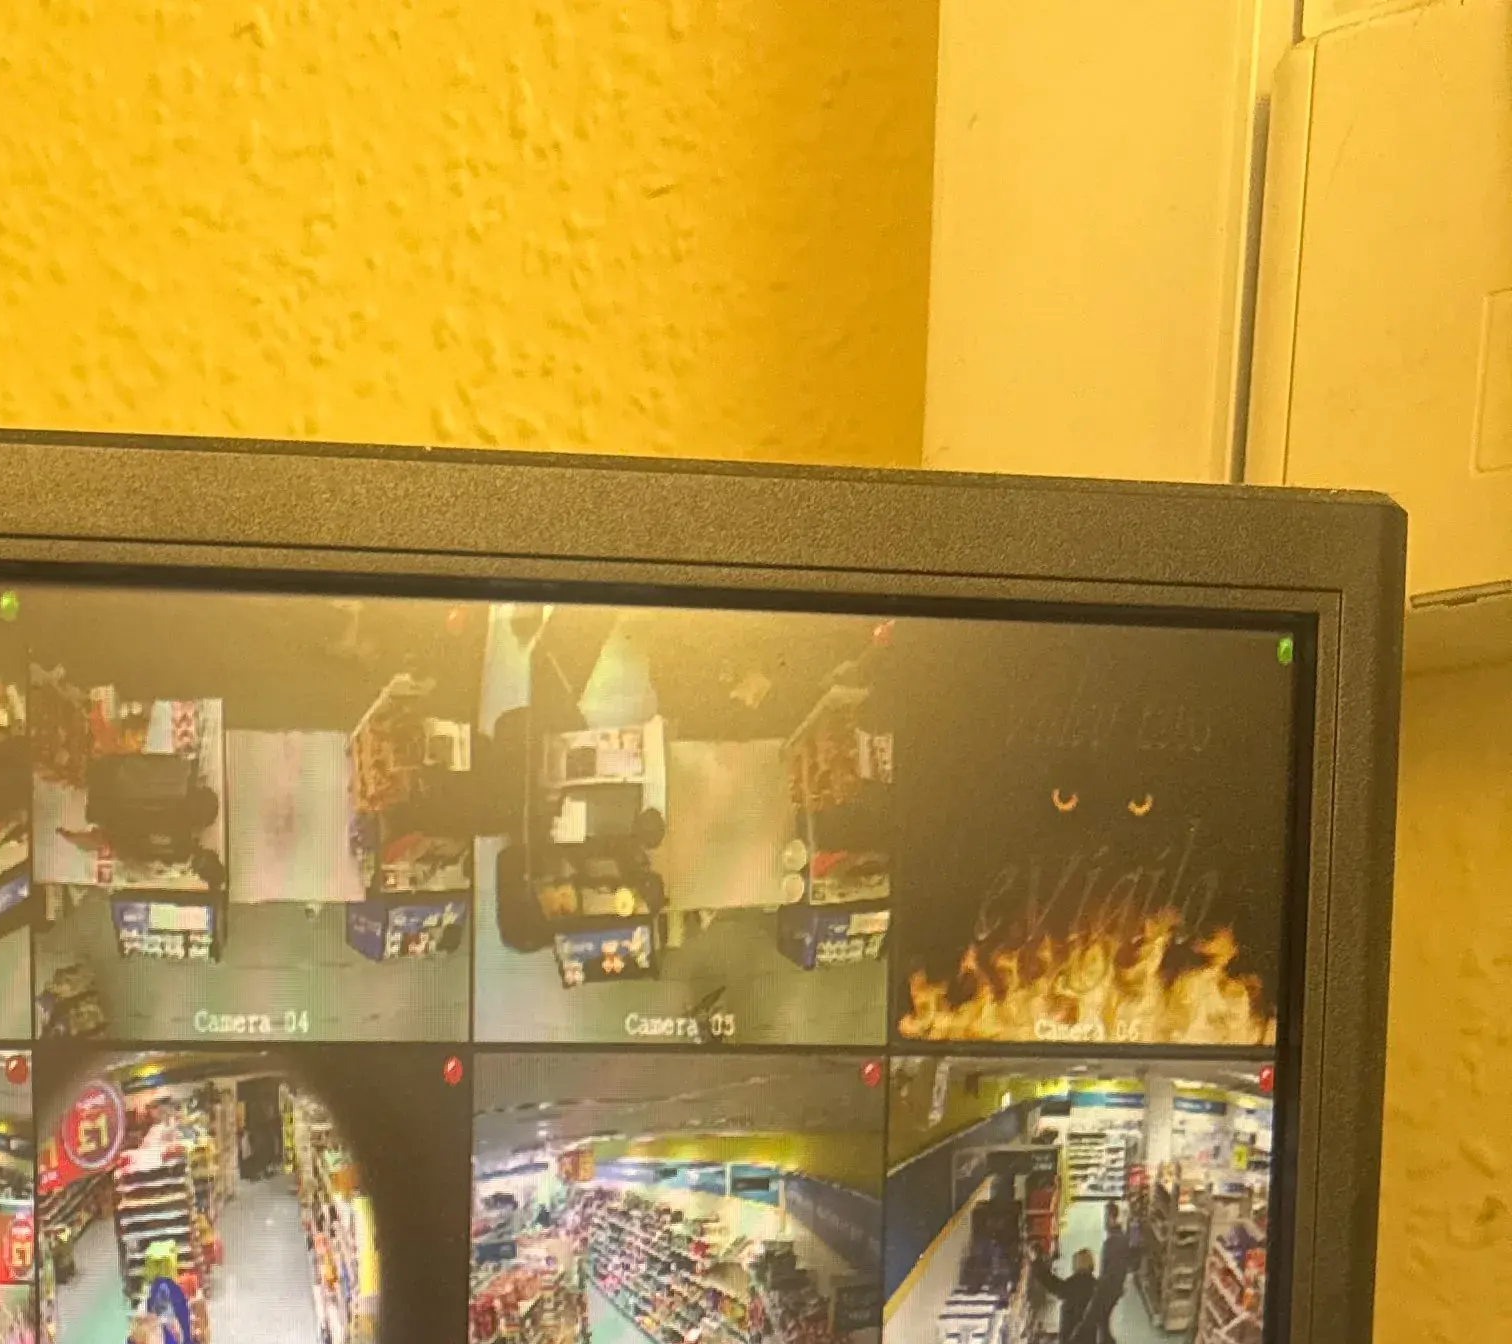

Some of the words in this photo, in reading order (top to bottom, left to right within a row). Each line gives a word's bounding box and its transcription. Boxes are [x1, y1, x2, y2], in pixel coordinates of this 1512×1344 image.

[193, 1009, 271, 1035] Camera
[283, 1010, 309, 1034] 04
[624, 1012, 700, 1037] Camera
[1035, 1018, 1105, 1041] Camera
[1116, 1019, 1141, 1042] 06
